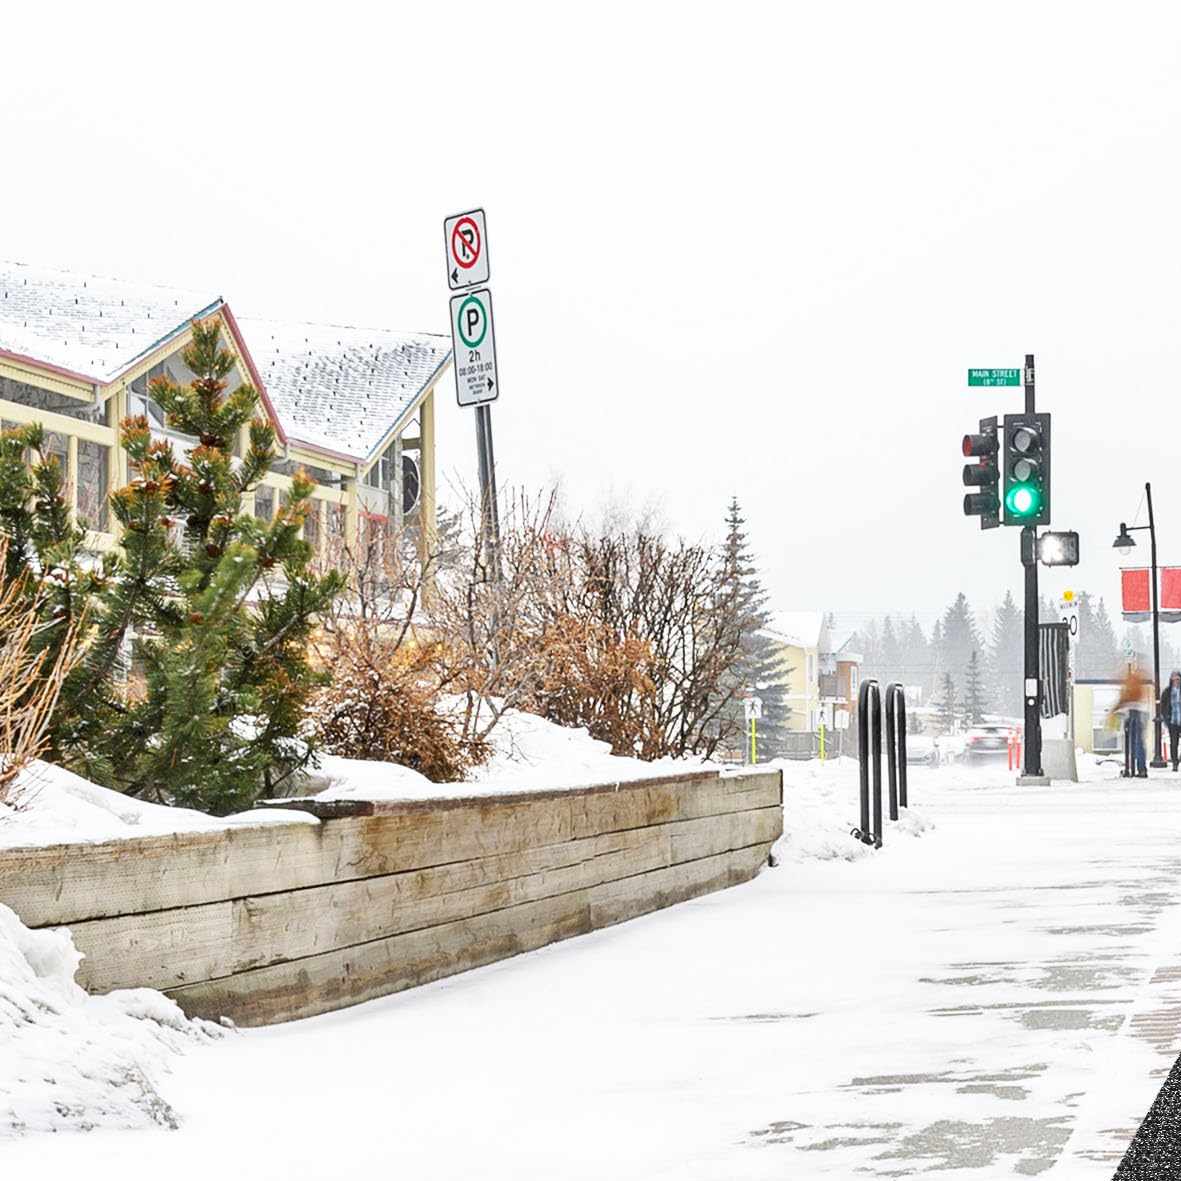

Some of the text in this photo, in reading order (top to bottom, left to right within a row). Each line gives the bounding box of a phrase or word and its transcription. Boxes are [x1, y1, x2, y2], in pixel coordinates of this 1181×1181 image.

[466, 308, 479, 336] P
[469, 349, 481, 363] 2h
[972, 370, 989, 378] MAIN
[992, 370, 1017, 378] STREET
